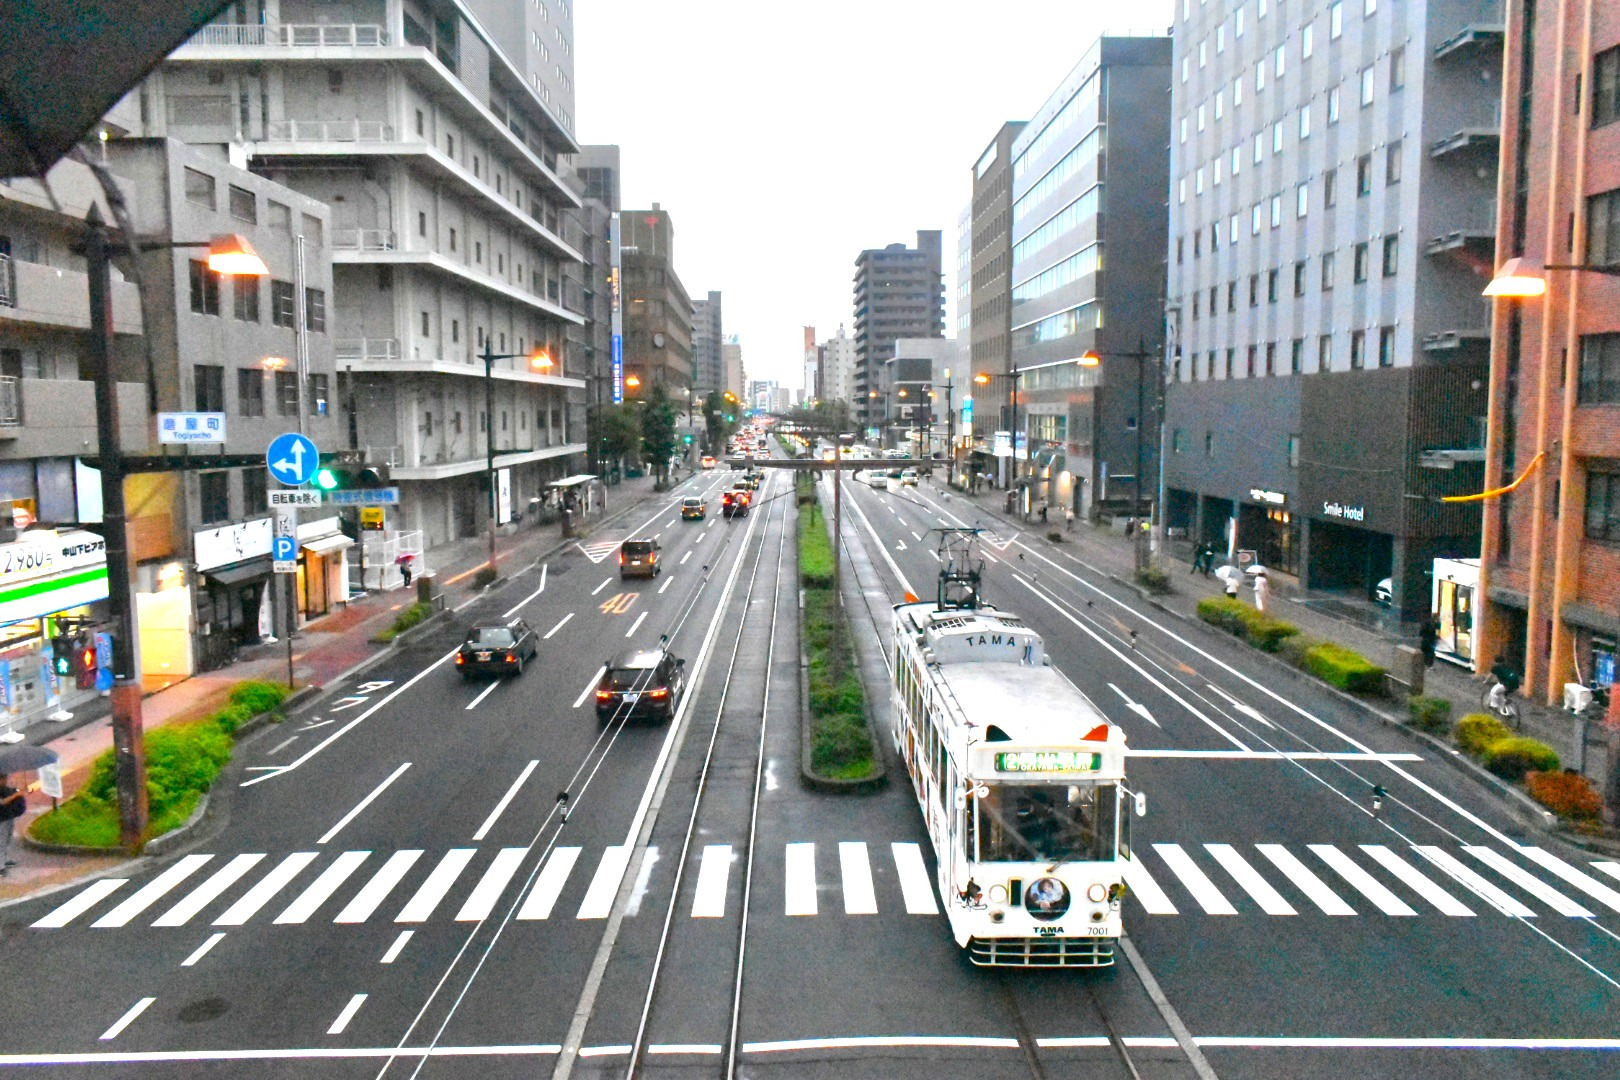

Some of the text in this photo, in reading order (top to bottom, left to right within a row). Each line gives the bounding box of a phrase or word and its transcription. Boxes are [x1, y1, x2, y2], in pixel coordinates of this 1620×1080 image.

[172, 431, 212, 440] Togiyacho
[272, 492, 318, 505] 自転車を除く
[1323, 501, 1365, 522] Smile Hotel
[277, 540, 293, 560] P
[599, 592, 641, 614] 40
[965, 634, 1016, 647] TAMA
[1032, 926, 1065, 934] TAMA
[1087, 926, 1109, 936] 7001
